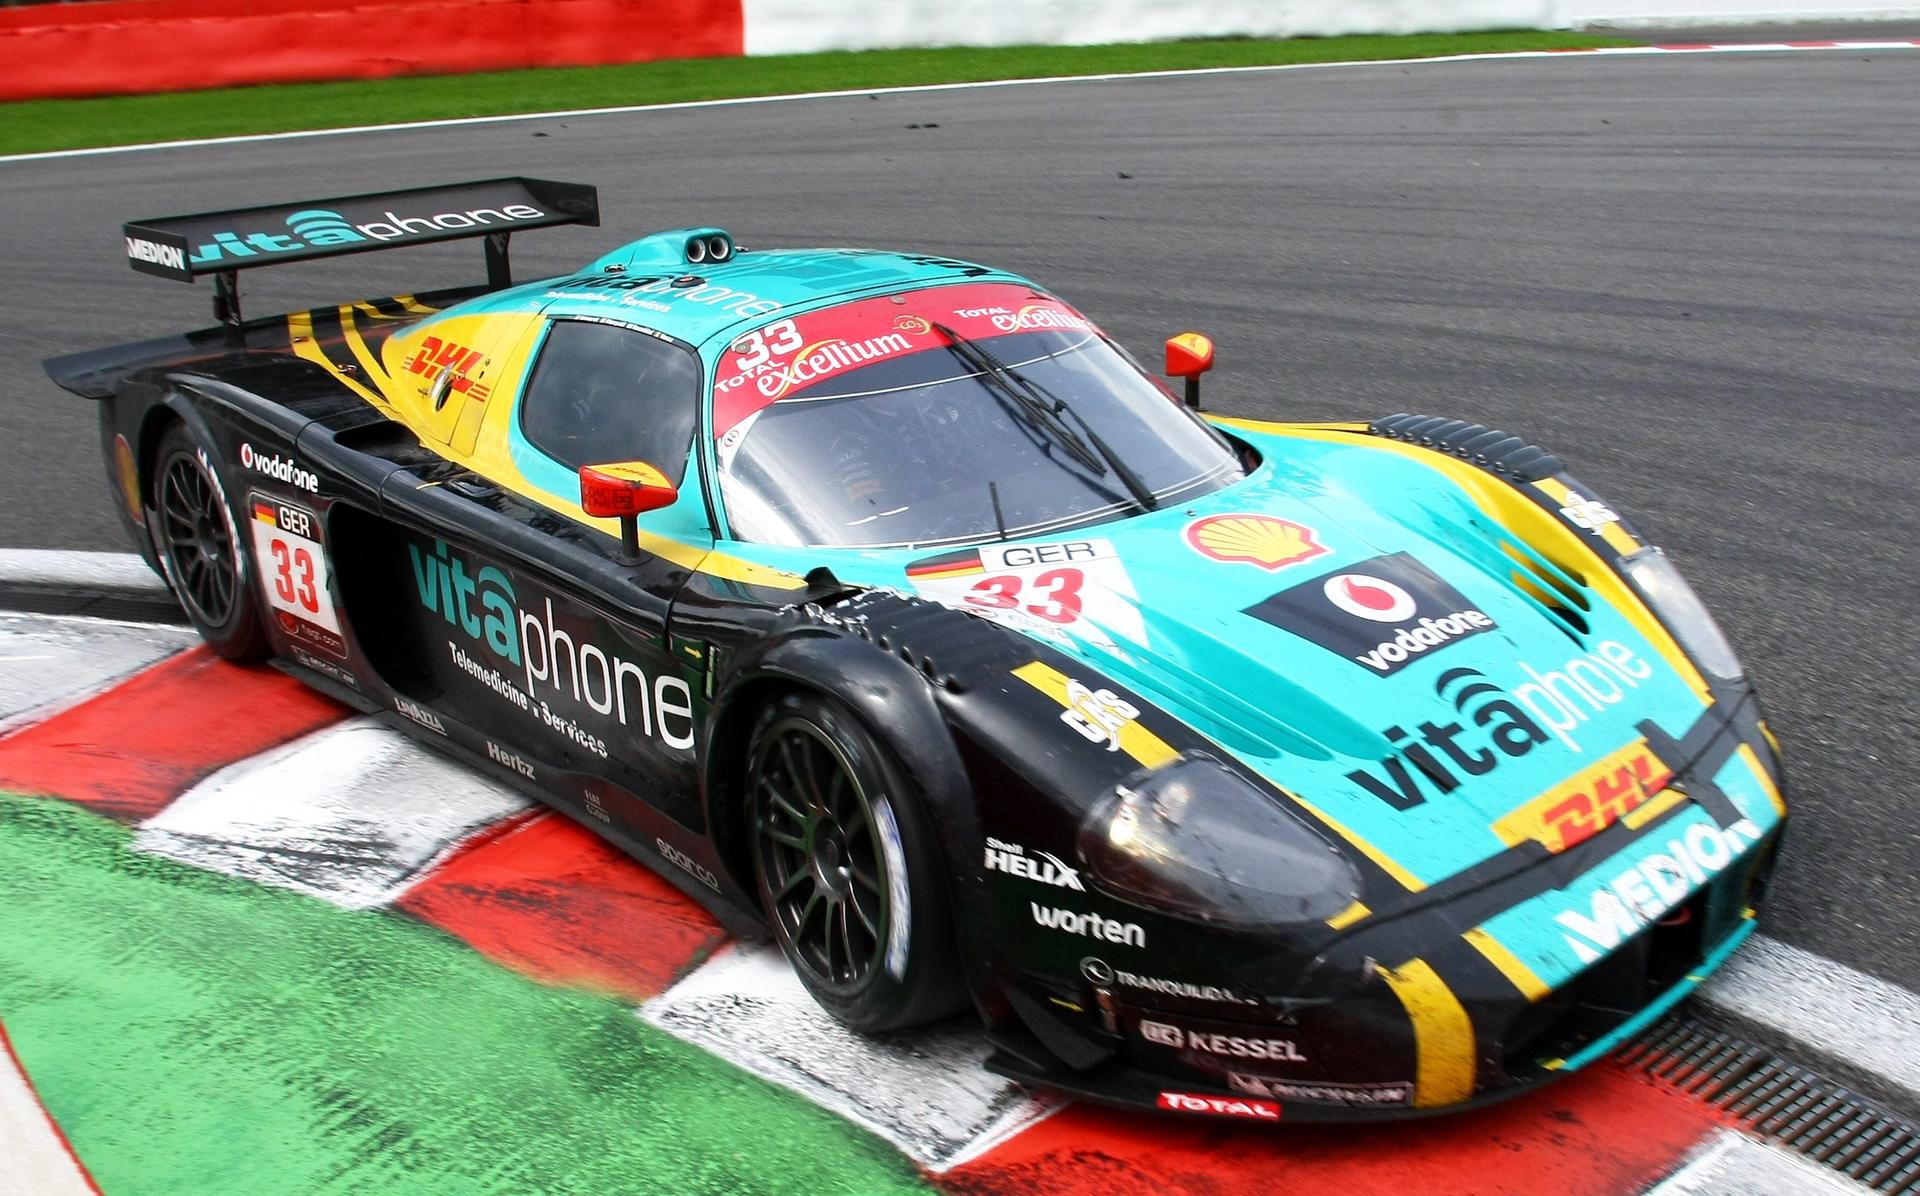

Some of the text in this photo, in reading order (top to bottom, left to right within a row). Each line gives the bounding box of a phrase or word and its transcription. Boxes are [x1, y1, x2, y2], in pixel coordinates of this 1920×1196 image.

[126, 236, 185, 270] MEDION
[953, 306, 1012, 319] TOTAL
[410, 336, 484, 393] DHL
[731, 319, 804, 371] 33
[756, 333, 913, 397] excellium
[714, 360, 784, 393] TOTAL
[254, 452, 318, 493] vodafone
[279, 507, 310, 537] GER
[270, 538, 319, 614] 33
[1002, 542, 1096, 567] GER
[963, 568, 1085, 625] 33
[408, 538, 696, 750] vitaphone
[1356, 607, 1495, 673] vodafone
[449, 641, 608, 758] Telemedicine Services
[486, 741, 536, 780] Hertz
[1543, 755, 1668, 850] DHL
[656, 838, 718, 888] sparco
[984, 847, 1086, 892] HELIX
[1553, 818, 1762, 964] MEDION
[1031, 901, 1146, 948] worten
[1188, 1030, 1307, 1062] KESSEL
[1160, 1092, 1278, 1118] TOTAL
